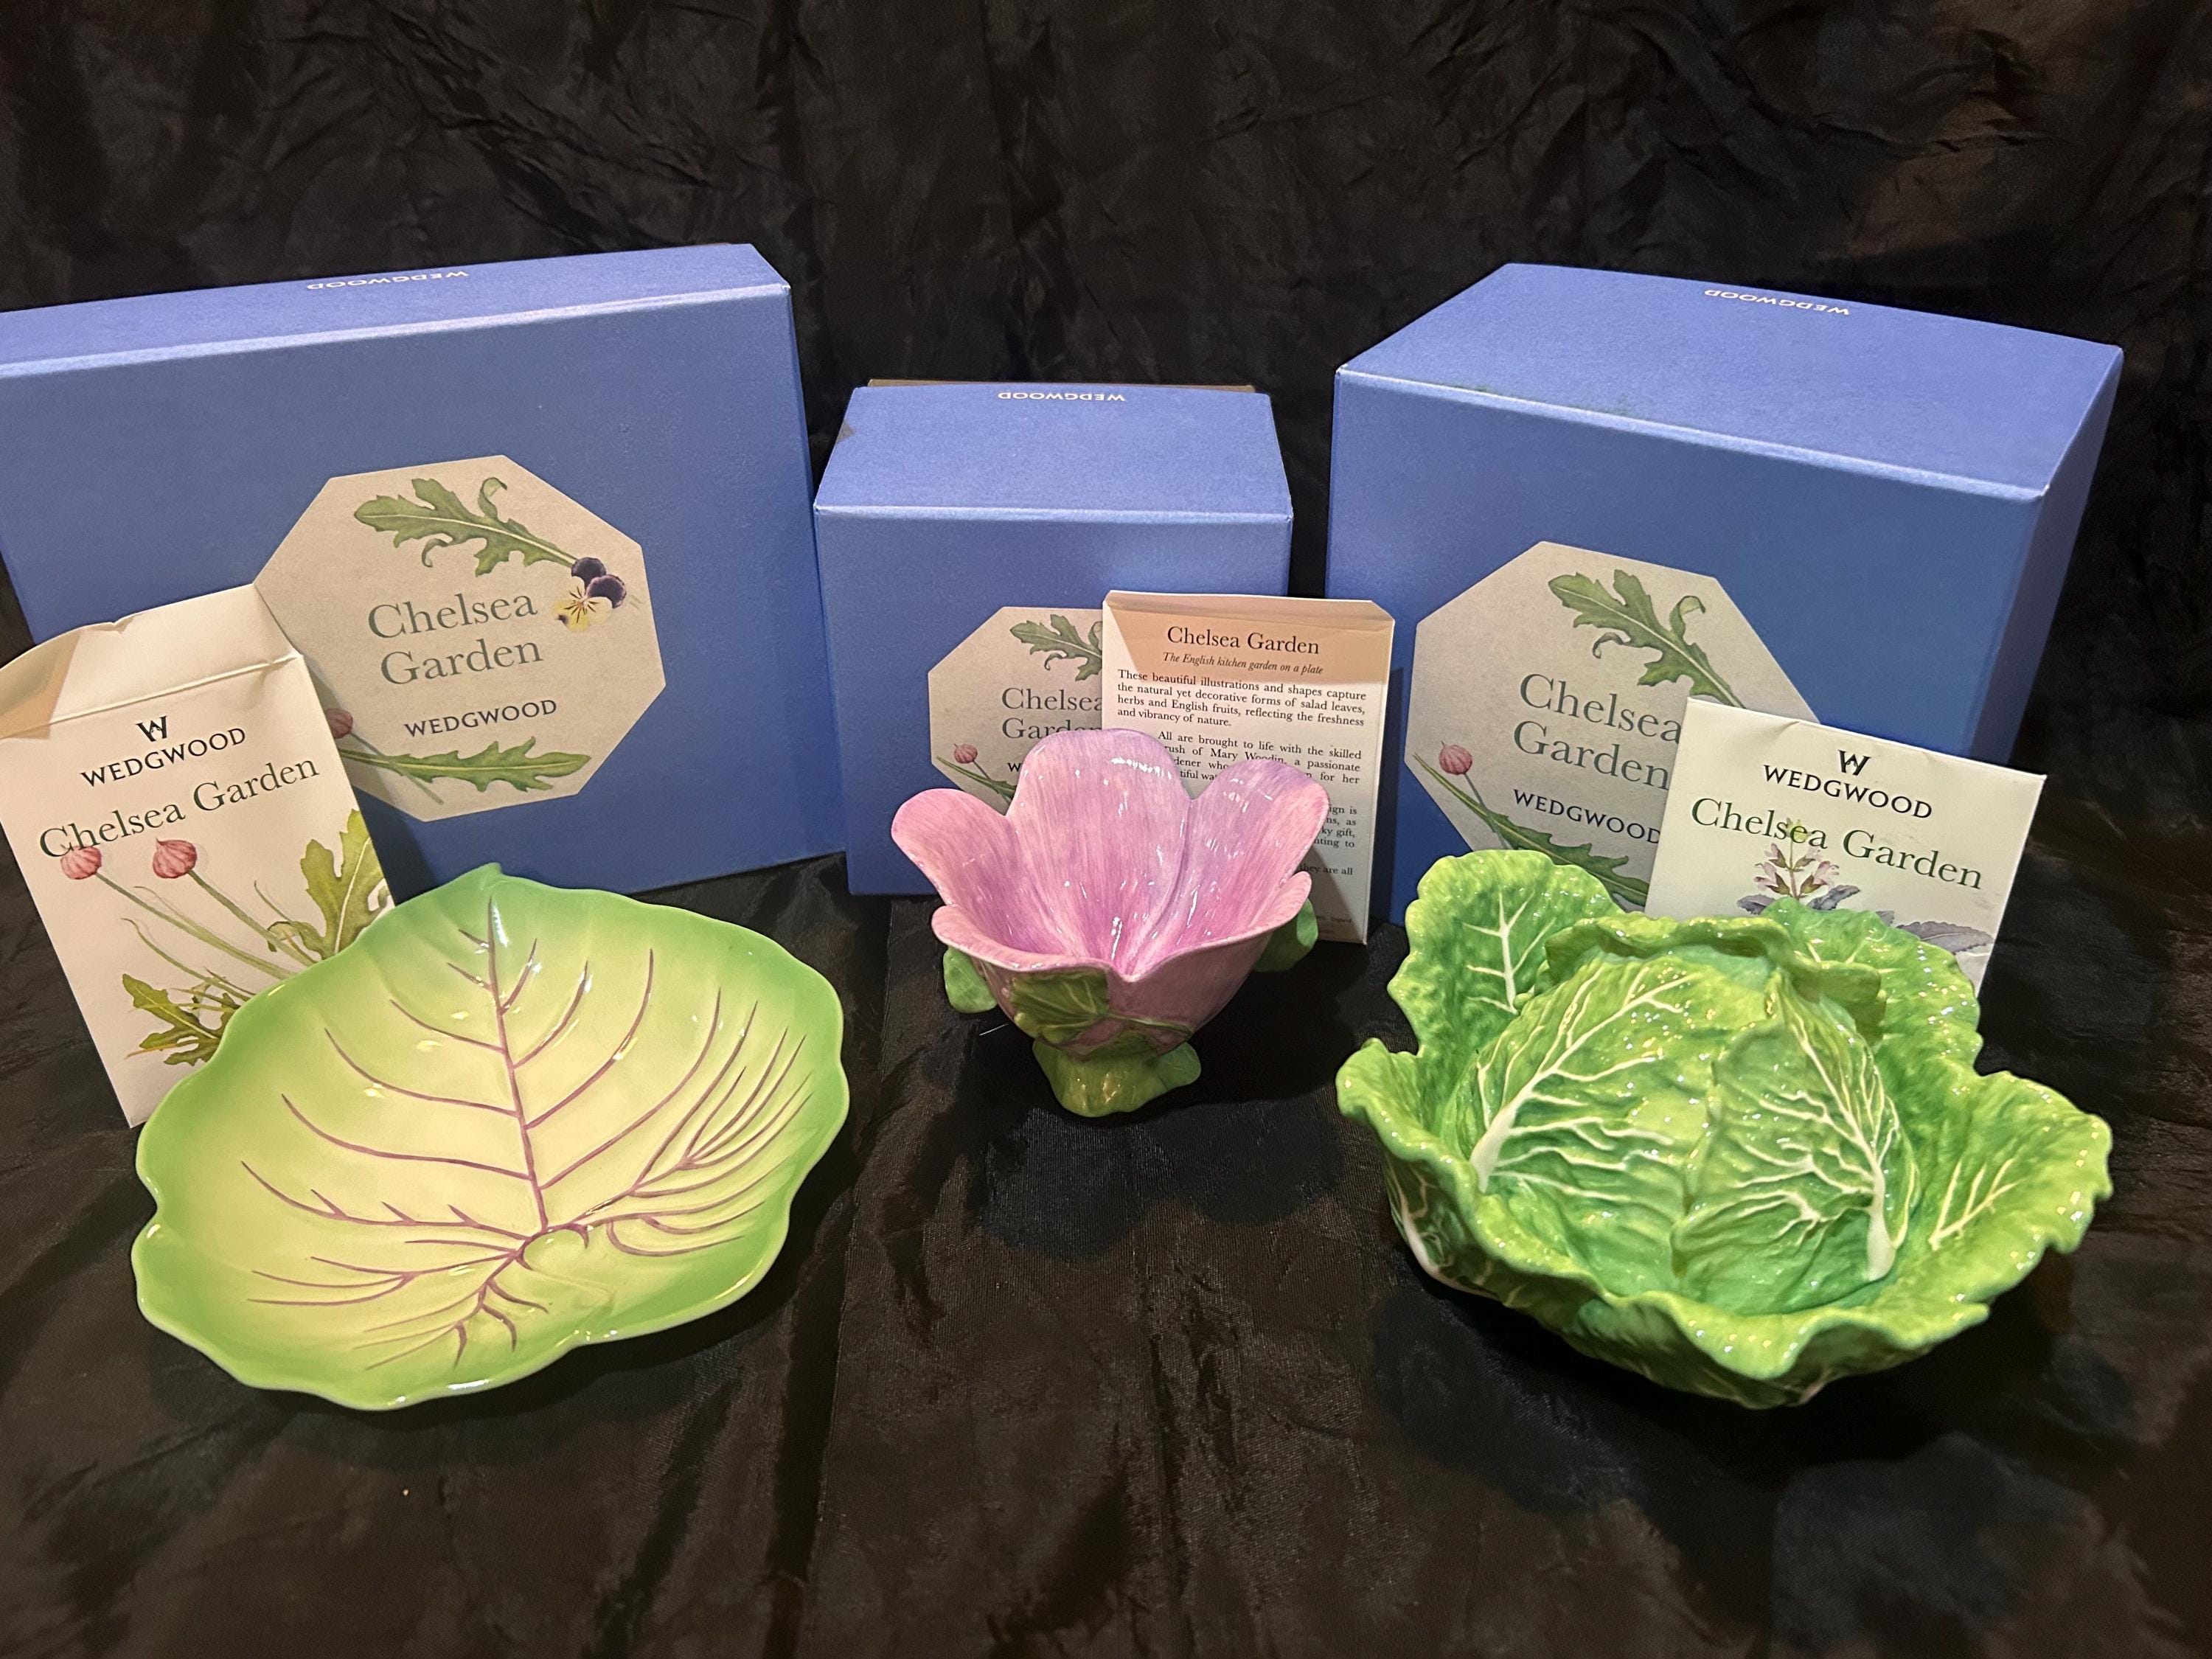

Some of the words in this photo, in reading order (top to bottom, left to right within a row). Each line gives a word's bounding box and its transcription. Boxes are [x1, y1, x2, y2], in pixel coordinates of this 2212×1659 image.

[307, 271, 468, 290] WEDGWOOD
[1705, 289, 1849, 316] WEDGWOOD
[998, 392, 1126, 402] WEDGWOOD
[368, 594, 538, 639] Chelsea
[1167, 626, 1240, 648] Chelsea
[1247, 632, 1319, 655] Garden
[380, 639, 544, 685] Garden
[1163, 652, 1180, 662] The
[1183, 653, 1214, 667] English
[1217, 657, 1247, 668] kitchen
[1248, 661, 1277, 672] garden
[1301, 664, 1324, 676] plate
[1118, 669, 1148, 681] These
[1152, 672, 1196, 686] beautiful
[1201, 677, 1259, 691] illustrations
[1264, 684, 1283, 693] and
[1288, 684, 1322, 697] shapes
[1326, 689, 1366, 701] capture
[1118, 683, 1133, 692] the
[1137, 686, 1172, 696] natural
[1176, 690, 1192, 699] yet
[1195, 689, 1248, 703] decorative
[1251, 694, 1281, 706] forms
[1285, 698, 1297, 707] of
[1301, 700, 1327, 710] salad
[1332, 701, 1366, 715] leaves,
[404, 699, 557, 737] WEDGWOOD
[1118, 695, 1144, 706] herbs
[1149, 699, 1167, 708] and
[1172, 700, 1208, 712] English
[1212, 703, 1241, 716] fruits,
[1245, 707, 1293, 722] reflecting
[1297, 712, 1313, 722] the
[1318, 712, 1365, 726] freshness
[1118, 708, 1135, 717] and
[1138, 709, 1180, 723] vibrancy
[1183, 714, 1194, 723] of
[1197, 717, 1231, 726] nature.
[1520, 673, 1682, 745] Chelsea
[80, 727, 246, 787] WEDGWOOD
[1158, 731, 1172, 740] All
[1198, 734, 1238, 748] brought
[1243, 741, 1253, 749] to
[1259, 741, 1274, 751] life
[1280, 744, 1301, 754] with
[1307, 746, 1324, 756] the
[1329, 747, 1362, 759] skilled
[1192, 747, 1203, 755] of
[1211, 748, 1238, 762] Mary
[1307, 759, 1361, 772] passionate
[1514, 720, 1670, 791] Garden
[1173, 757, 1201, 768] dener
[1320, 772, 1335, 782] for
[1342, 773, 1360, 784] her
[1180, 770, 1199, 779] tiful
[1763, 765, 1933, 819] WEDGWOOD
[39, 803, 186, 859] Chelsea
[192, 757, 320, 813] Garden
[1349, 806, 1357, 815] is
[1513, 788, 1660, 844] WEDGWOOD
[1336, 828, 1355, 838] gift,
[1691, 797, 1828, 849] Chelsea
[1843, 830, 1982, 890] Garden
[1341, 867, 1353, 875] all
